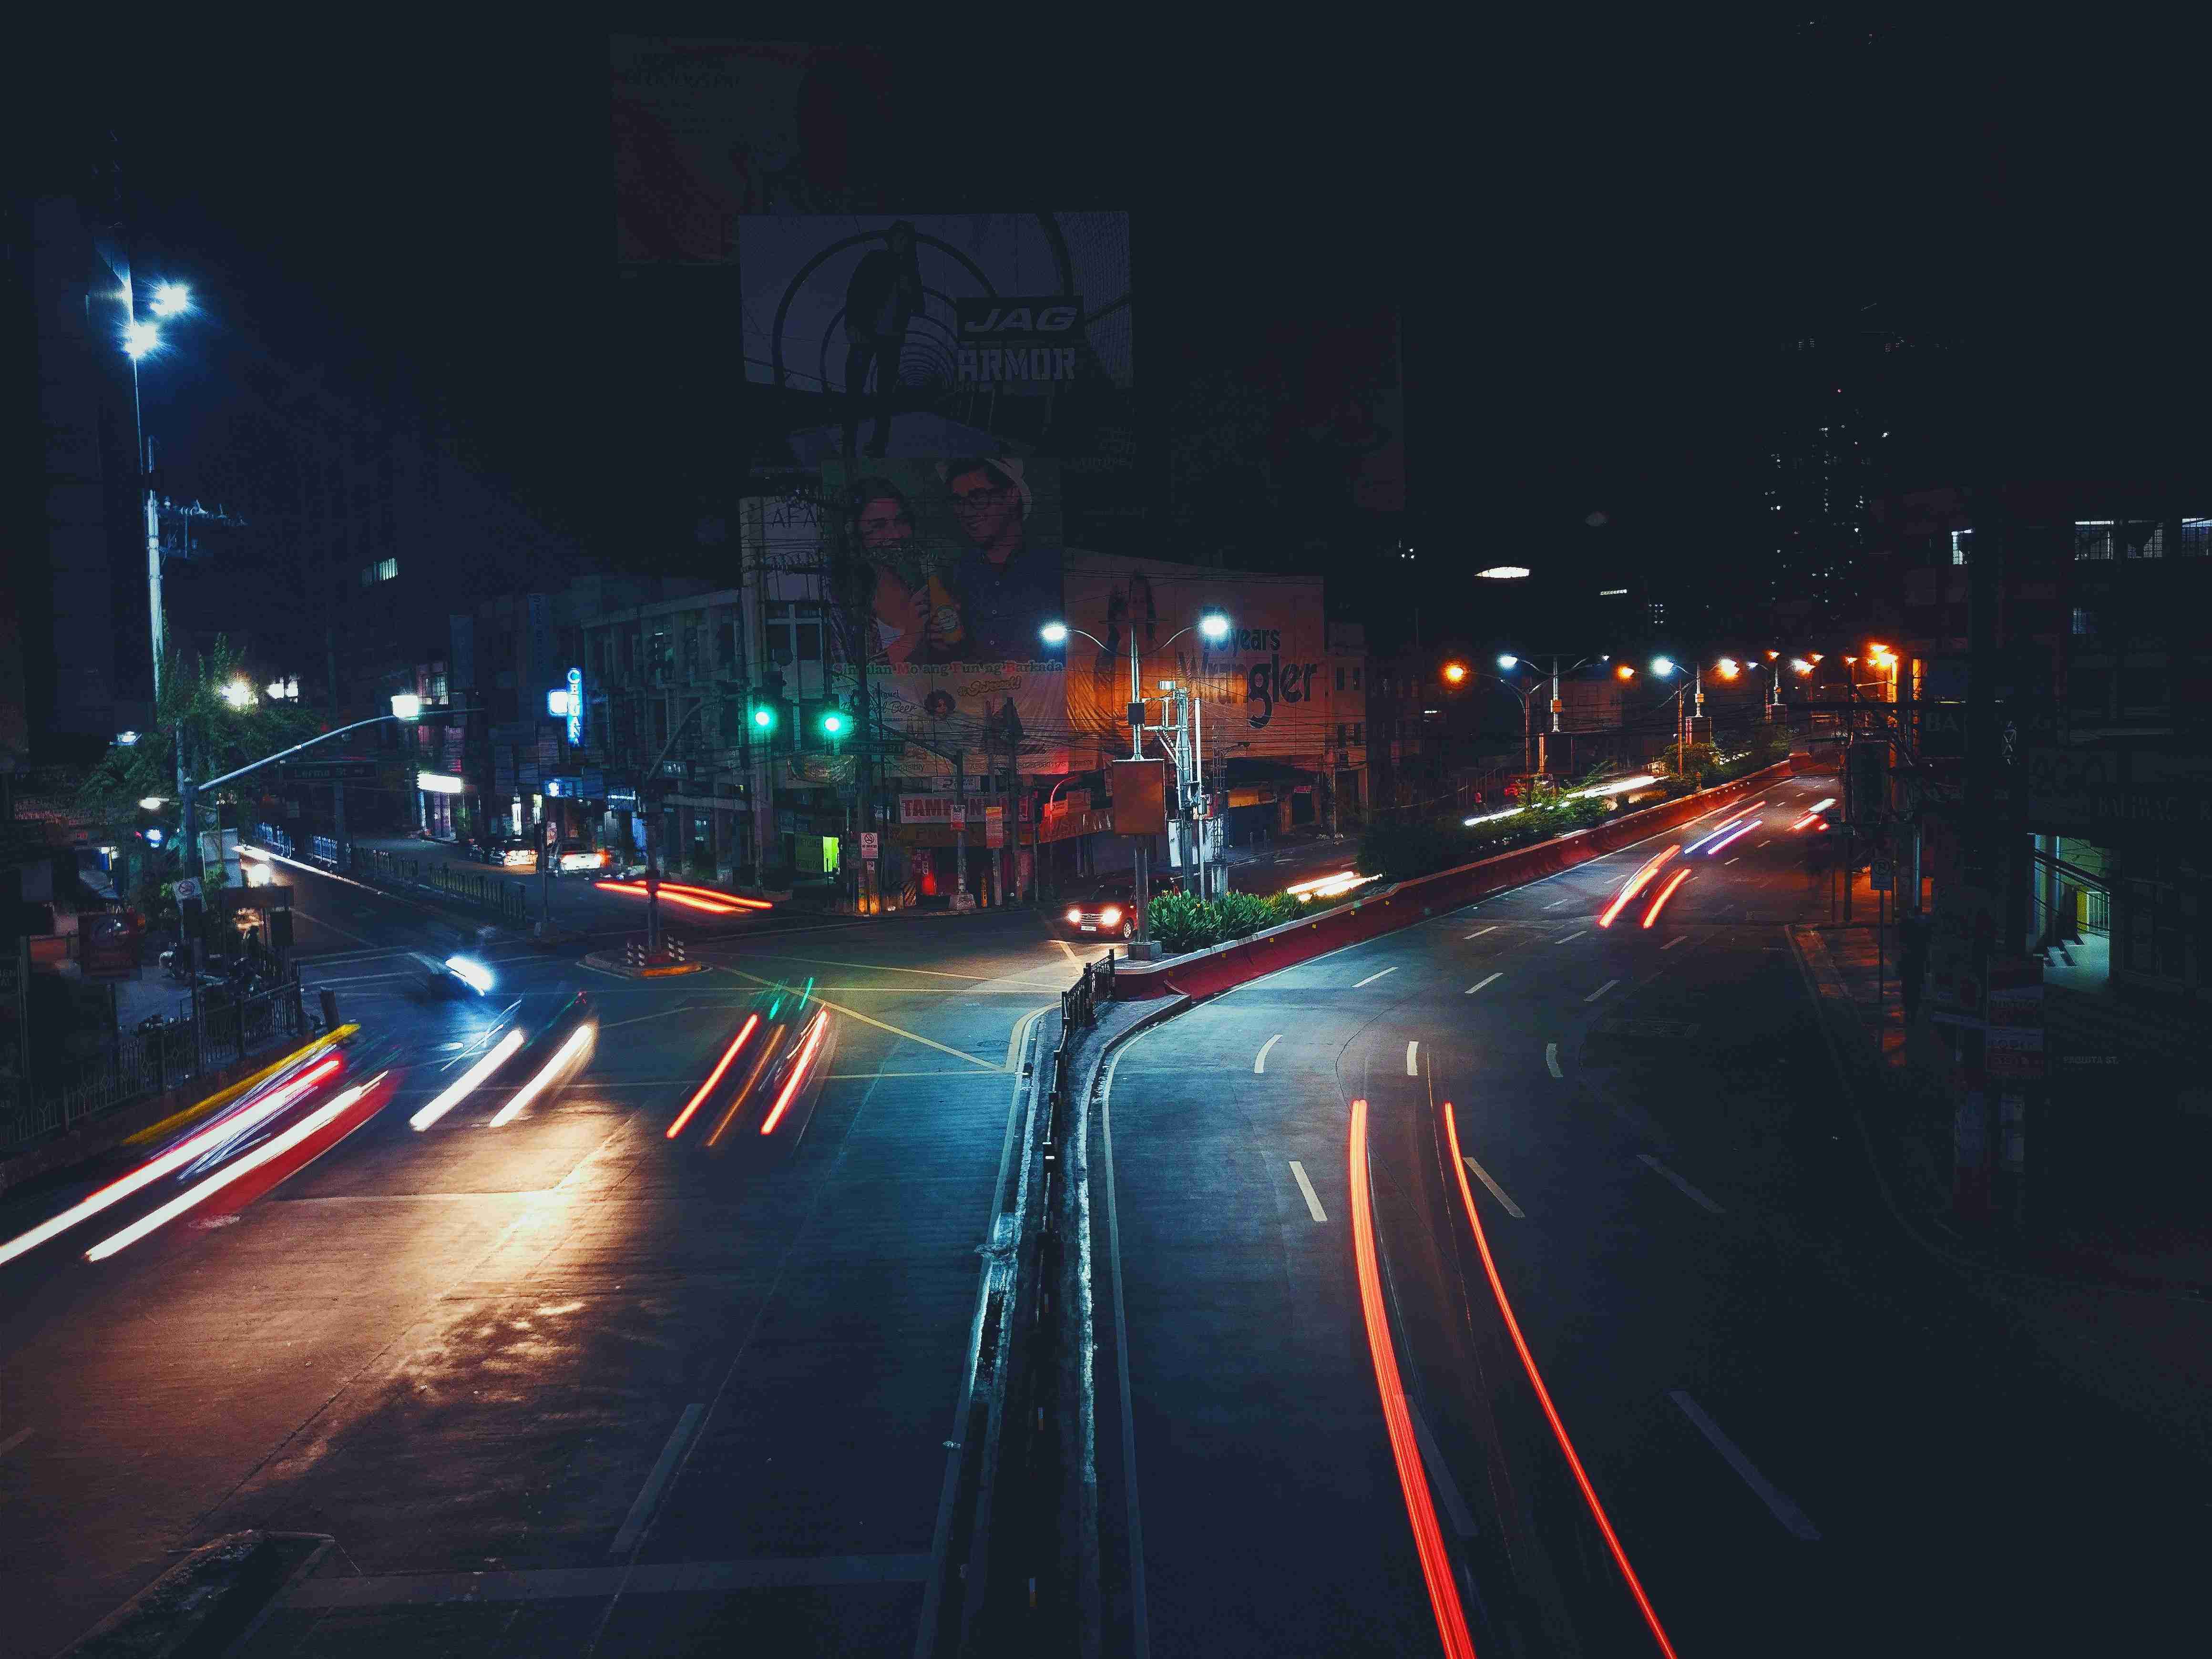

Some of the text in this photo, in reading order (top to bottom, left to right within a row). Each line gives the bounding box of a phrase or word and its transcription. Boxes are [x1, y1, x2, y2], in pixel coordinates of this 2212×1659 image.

[964, 305, 1079, 332] JAG
[957, 347, 1076, 382] ARMOR
[1178, 653, 1318, 728] Wrangler
